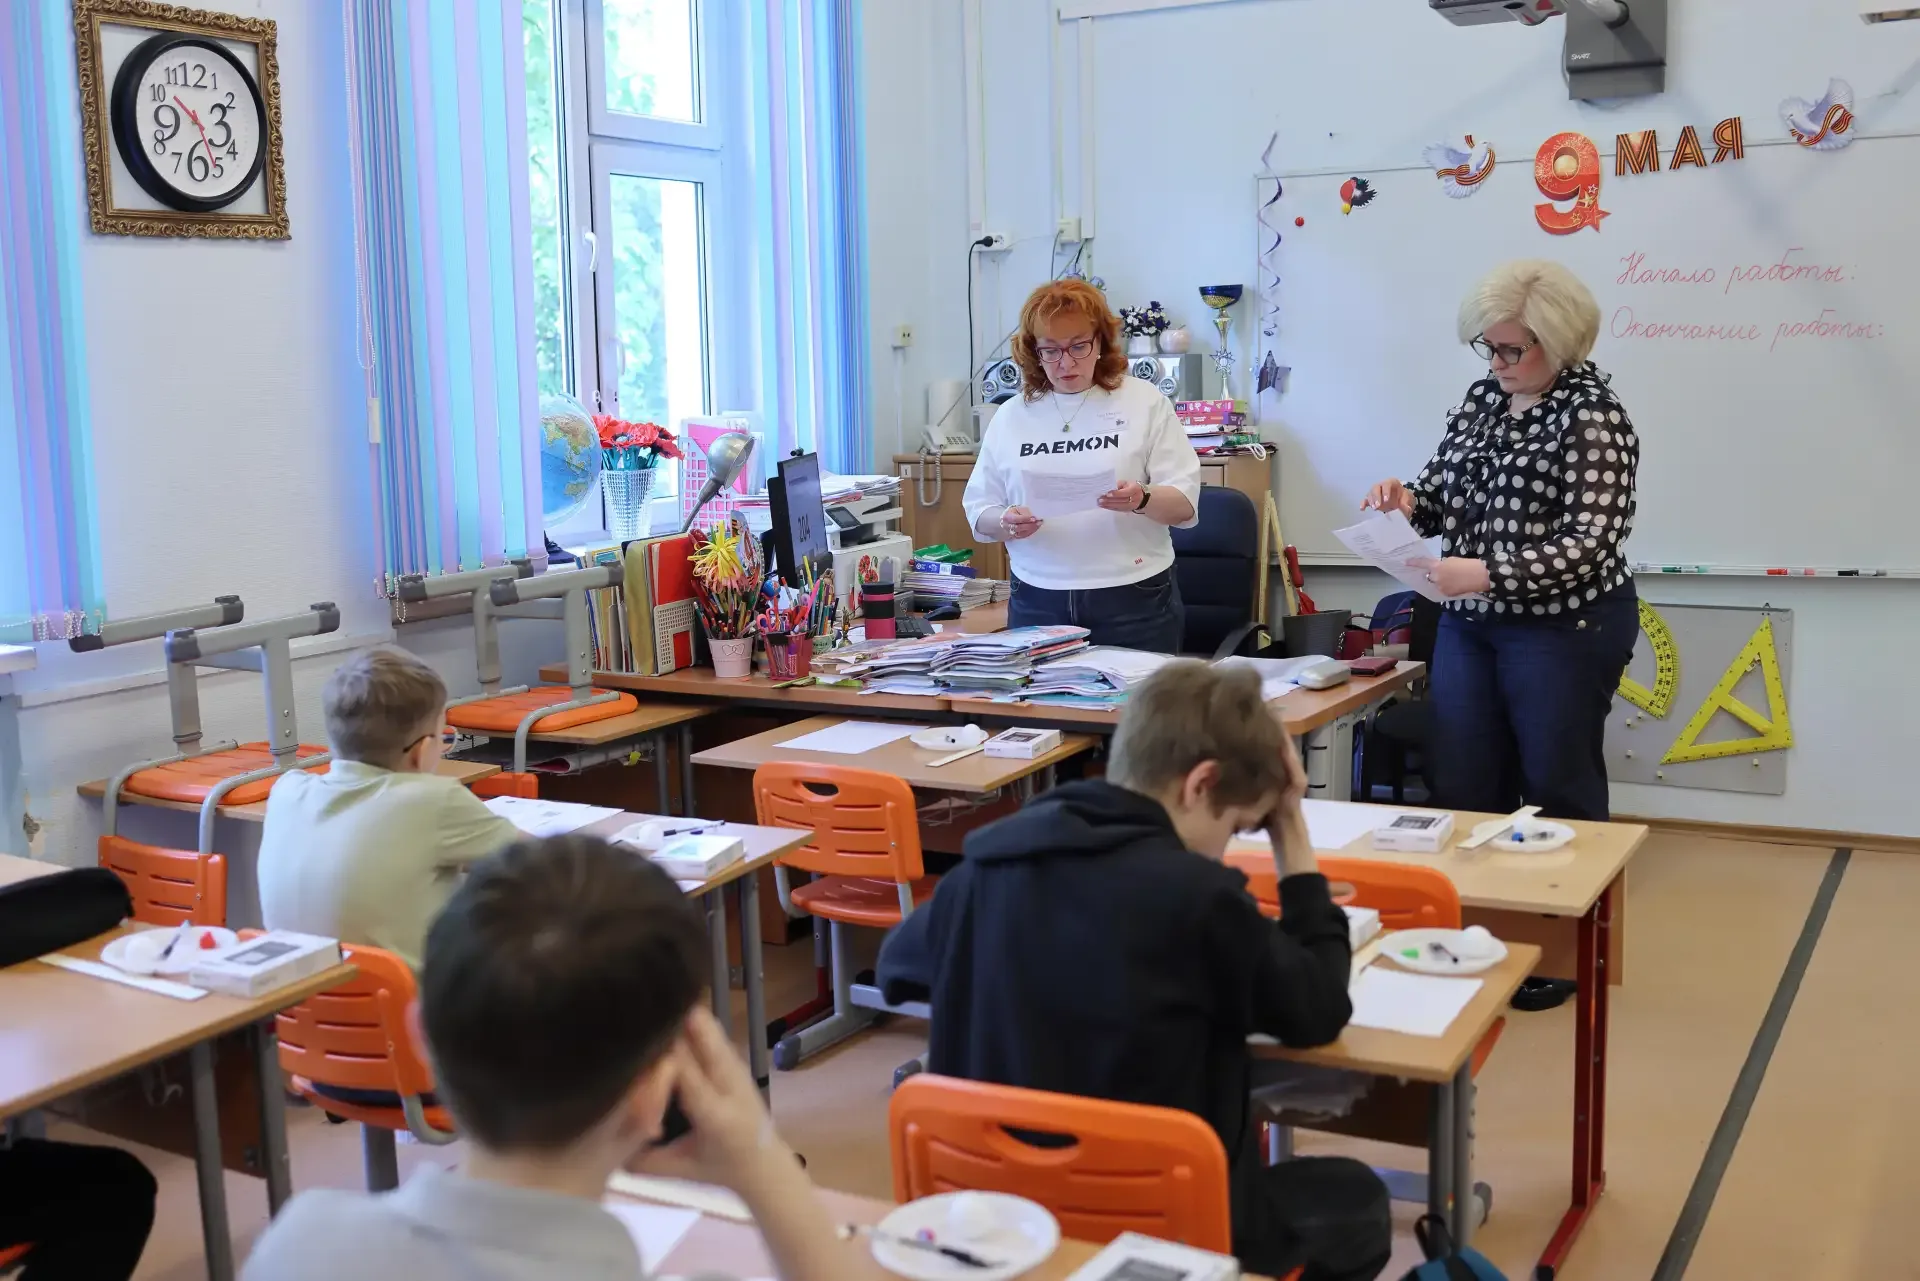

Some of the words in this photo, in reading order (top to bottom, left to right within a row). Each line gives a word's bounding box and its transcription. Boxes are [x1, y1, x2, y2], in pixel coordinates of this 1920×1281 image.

[164, 66, 179, 86] 11
[178, 61, 208, 89] 12
[211, 72, 218, 90] 1
[150, 83, 166, 103] 10
[225, 91, 236, 109] 2
[153, 104, 181, 142] 9
[208, 103, 232, 148] 3
[153, 129, 166, 155] 8
[226, 138, 239, 161] 4
[171, 151, 183, 174] 7
[187, 139, 209, 183] 6
[212, 156, 224, 178] 5
[1534, 131, 1604, 236] 9
[1614, 116, 1745, 177] МАЯ
[1616, 251, 1716, 285] Начало
[1610, 305, 1762, 340] Окончание
[1769, 308, 1885, 352] работы:
[1019, 433, 1120, 458] BAEMON
